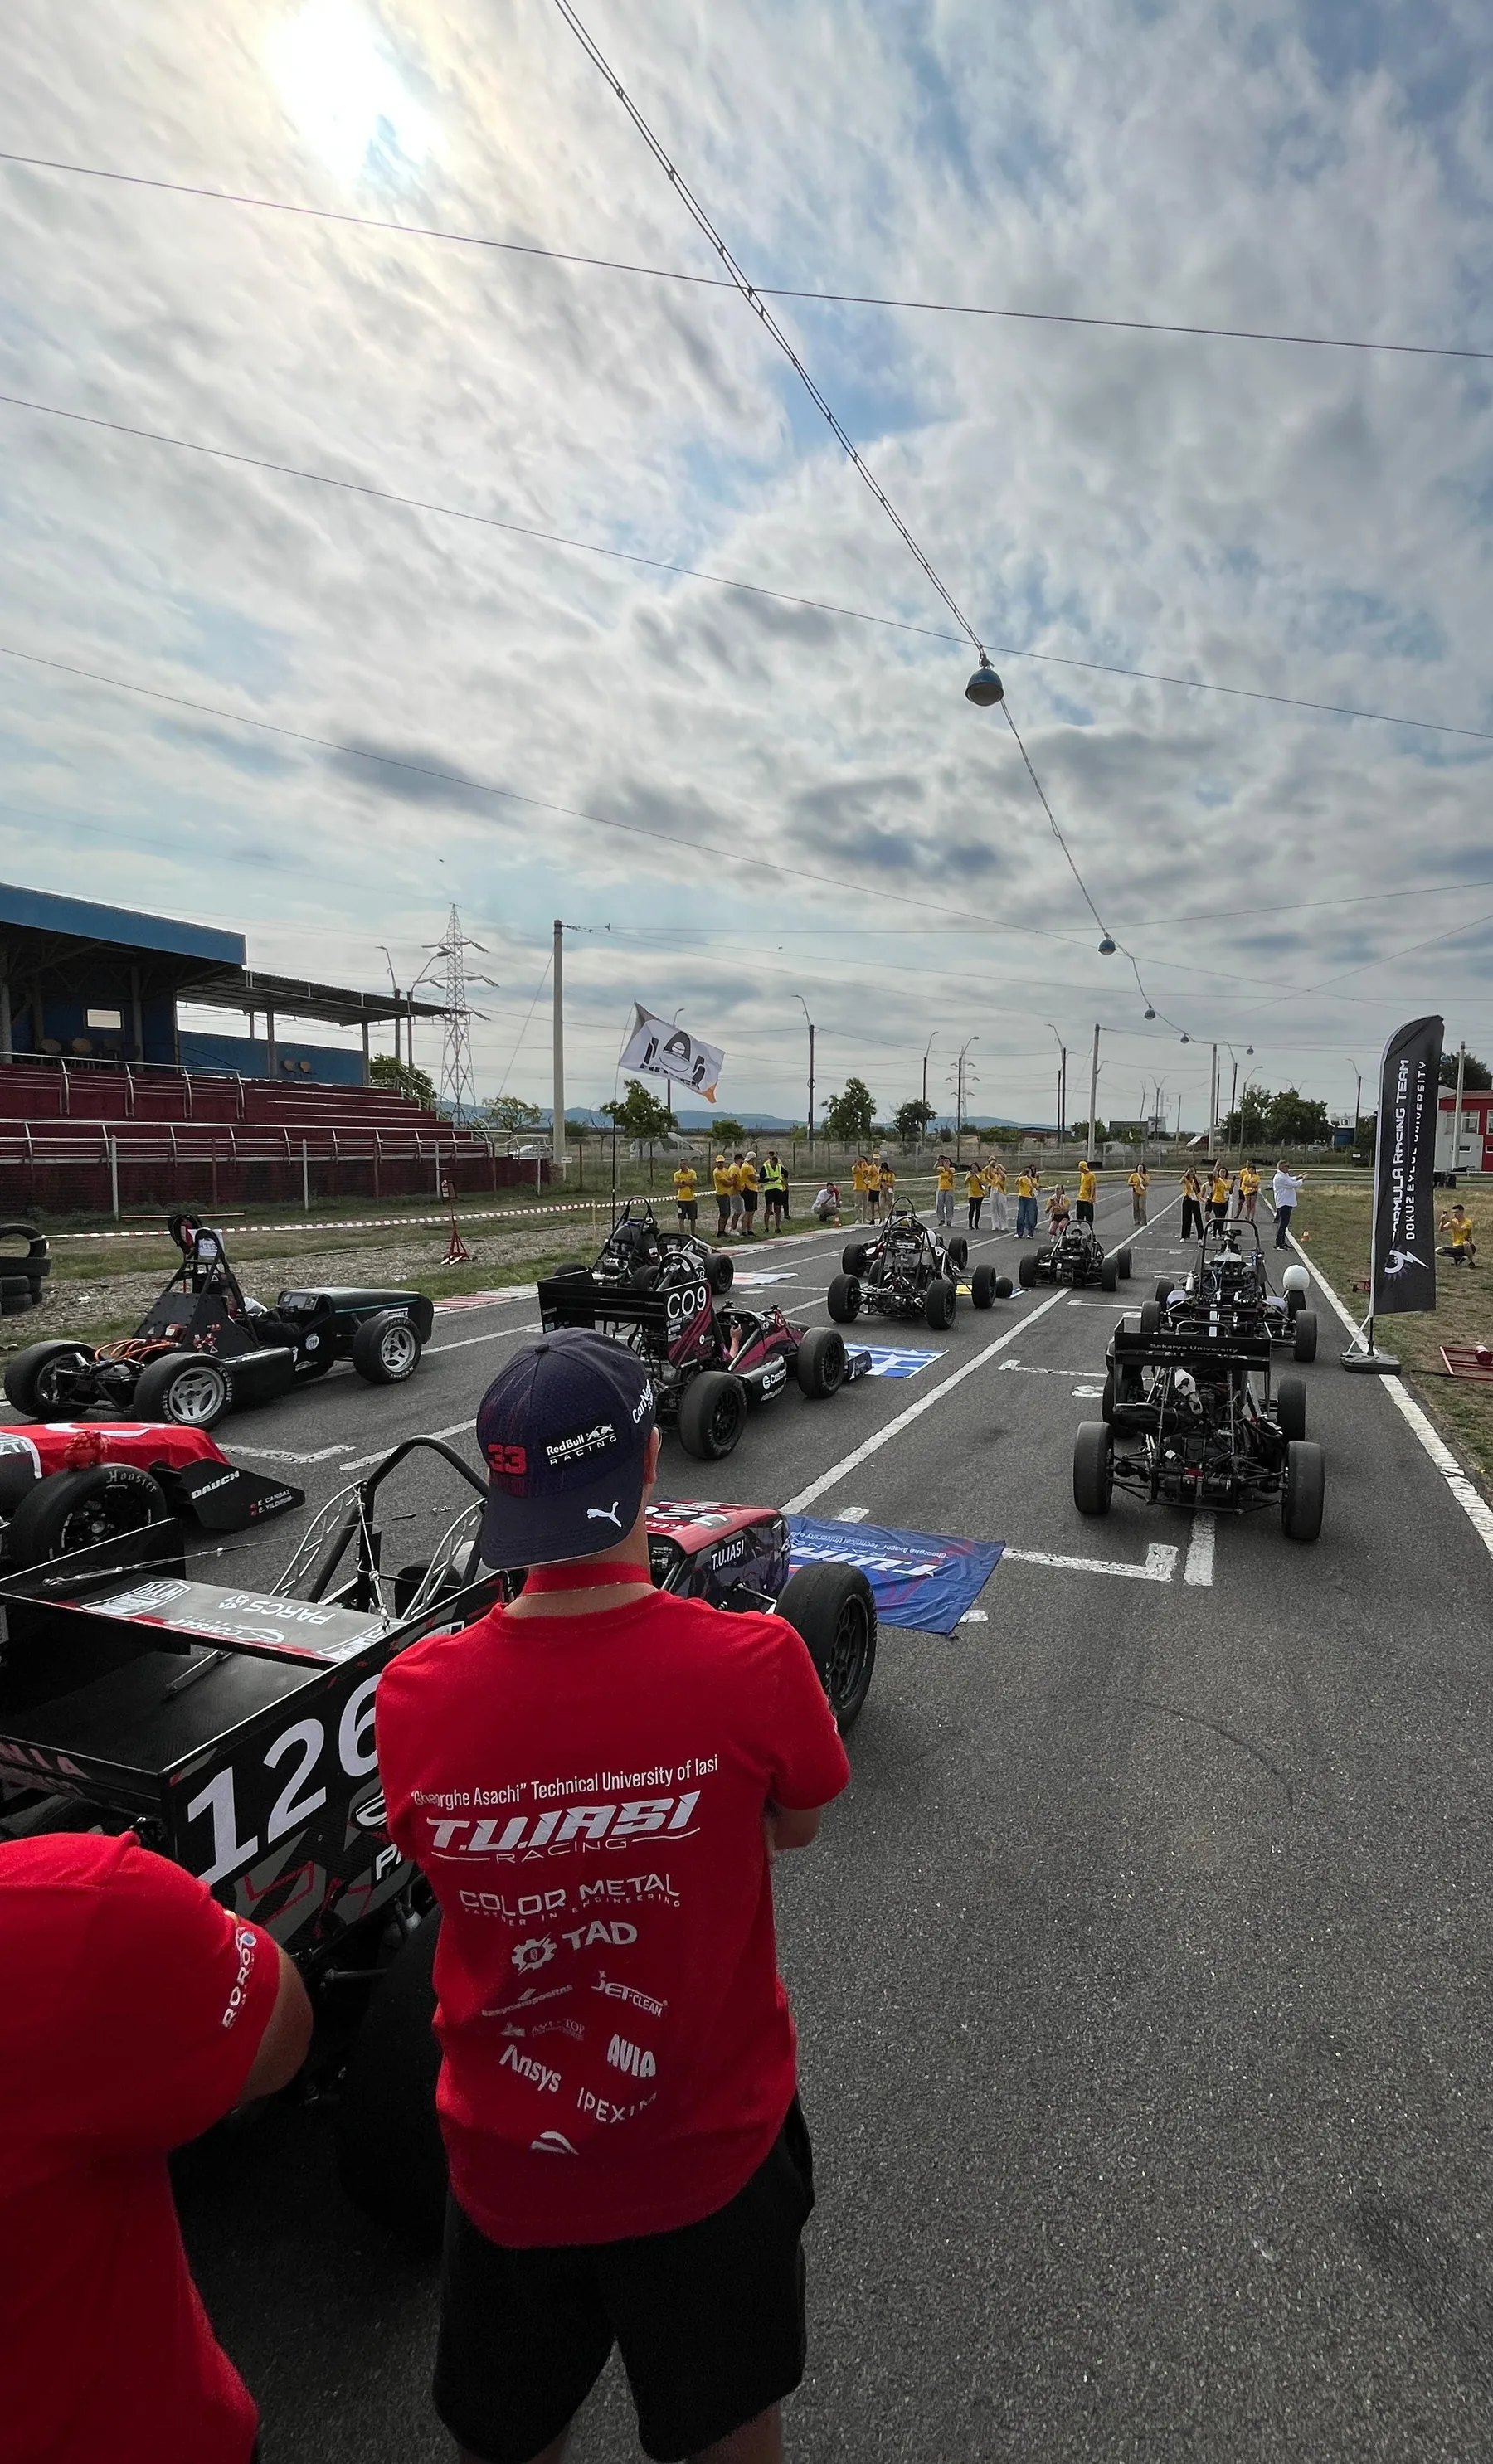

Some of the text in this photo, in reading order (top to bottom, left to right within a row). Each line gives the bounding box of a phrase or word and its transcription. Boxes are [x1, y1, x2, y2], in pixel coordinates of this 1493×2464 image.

[1396, 1059, 1409, 1104] TEAM
[1393, 1107, 1406, 1164] RACING
[1405, 1196, 1415, 1240] DOKUZ
[488, 1444, 526, 1474] 33
[549, 1435, 617, 1466] RACING
[106, 1470, 158, 1493] Hoosier
[191, 1470, 240, 1499] DAUCH
[711, 1539, 744, 1571] T.U.IASI
[242, 1599, 336, 1626] PARCS
[187, 1674, 379, 1886] 126
[531, 1772, 599, 1801] Technical
[602, 1766, 674, 1791] University
[677, 1760, 692, 1781] of
[695, 1754, 718, 1776] Iasi
[426, 1790, 702, 1852] T.U.IASI
[496, 1838, 627, 1864] RACING
[459, 1874, 680, 1917] COLOR METAL
[464, 1893, 681, 1927] PARTNER IN ENGINEERING
[562, 1920, 638, 1951] TAD
[498, 2034, 656, 2092] Ansys AVIA
